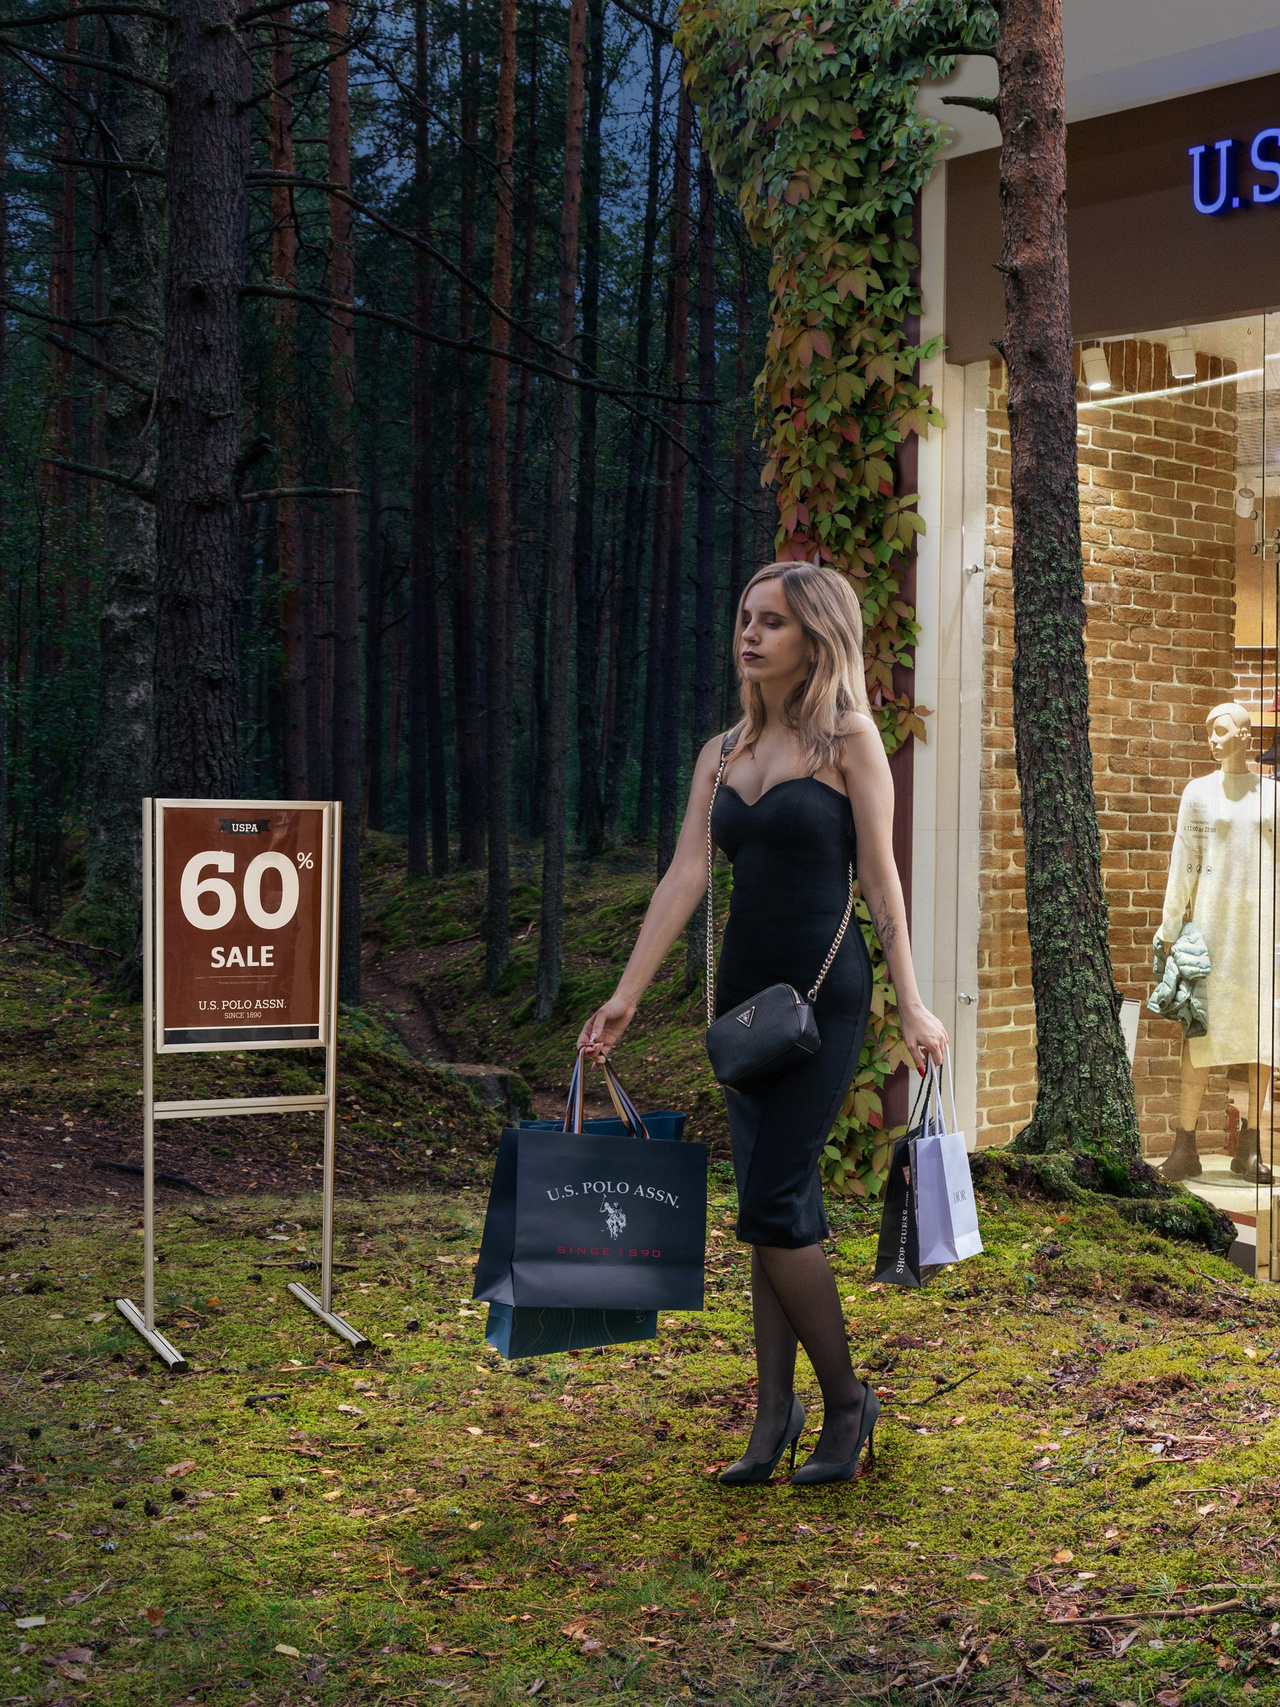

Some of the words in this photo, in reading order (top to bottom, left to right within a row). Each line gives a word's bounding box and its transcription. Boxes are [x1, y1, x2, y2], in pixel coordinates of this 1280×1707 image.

[232, 823, 258, 832] USPA
[210, 945, 275, 968] SALE
[198, 1000, 219, 1010] U.S.
[221, 999, 252, 1010] POLO
[254, 999, 287, 1009] ASSN.
[546, 1184, 579, 1201] U.S.
[582, 1180, 630, 1195] POLO
[633, 1184, 680, 1209] ASSN.
[953, 1189, 967, 1203] DIOR
[557, 1245, 611, 1256] SINCE
[619, 1249, 661, 1258] 1890
[896, 1246, 905, 1274] SHOP
